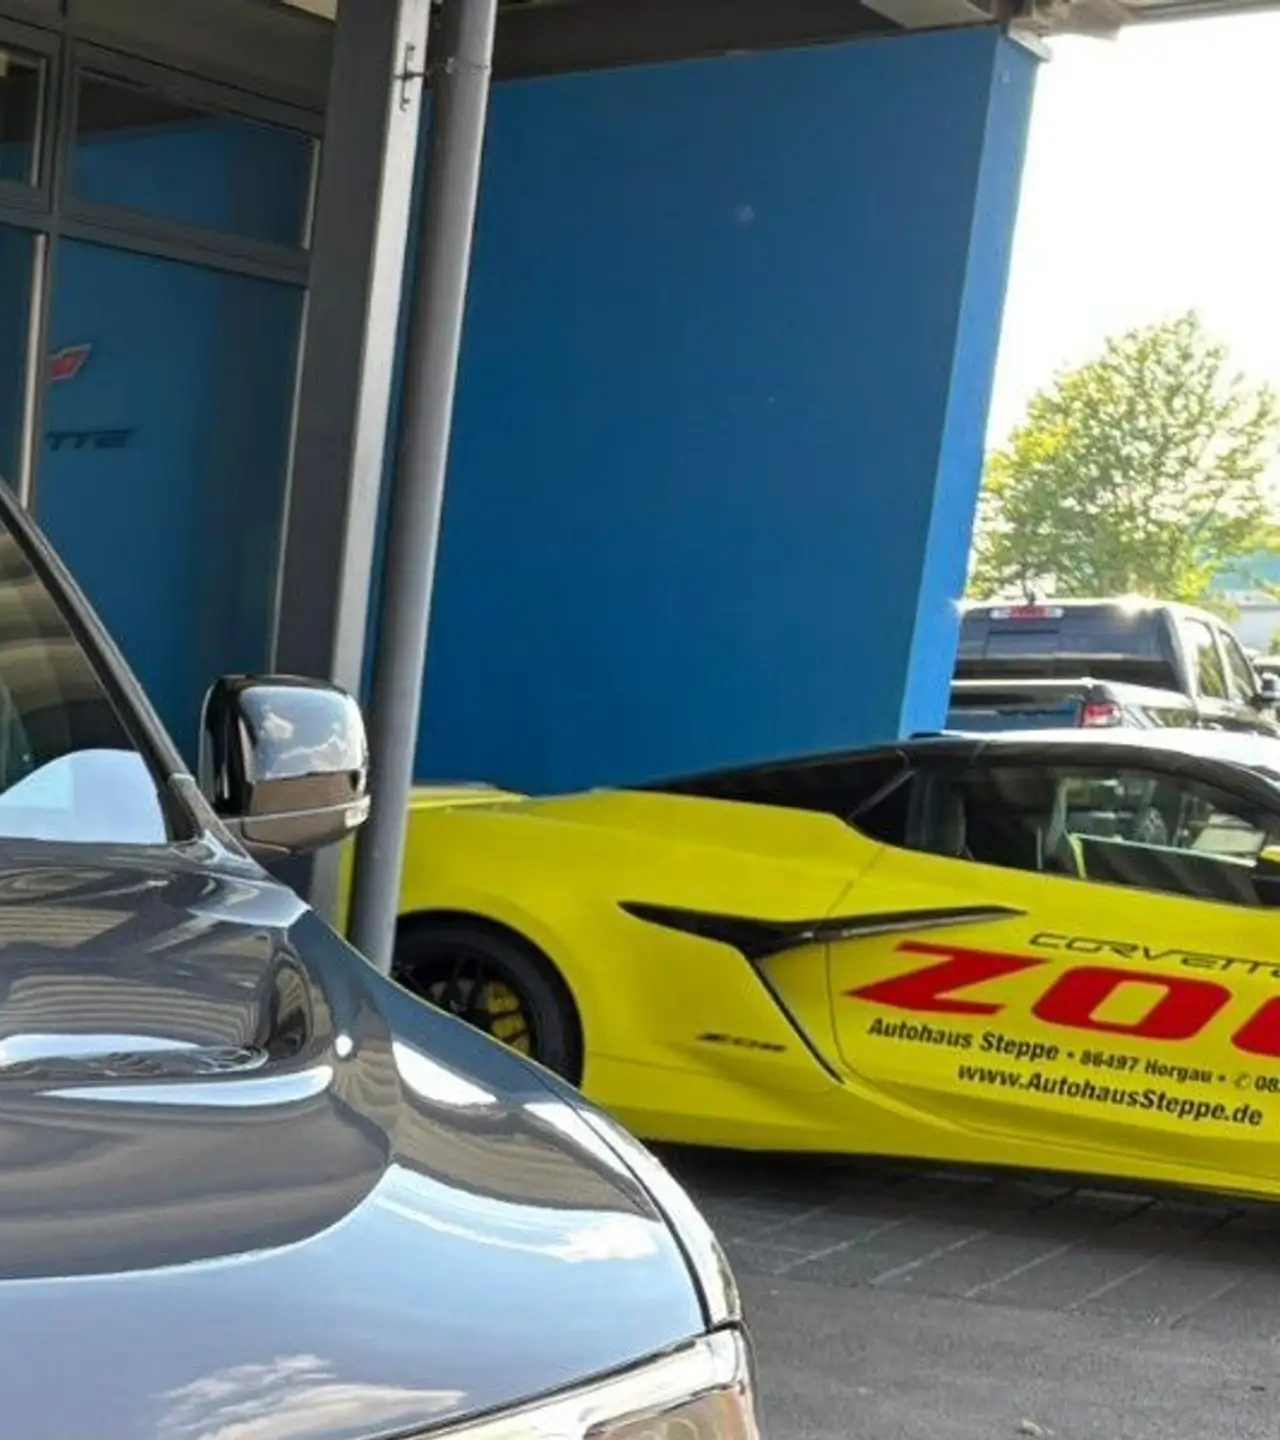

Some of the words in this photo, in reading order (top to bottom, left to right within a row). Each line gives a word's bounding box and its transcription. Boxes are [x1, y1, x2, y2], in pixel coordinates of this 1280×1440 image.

[867, 1017, 974, 1049] Autohaus
[979, 1031, 1060, 1062] Steppe
[1079, 1049, 1140, 1072] 86497
[1144, 1058, 1213, 1083] Horgau
[957, 1063, 1264, 1126] www.AutohausSteppe.de
